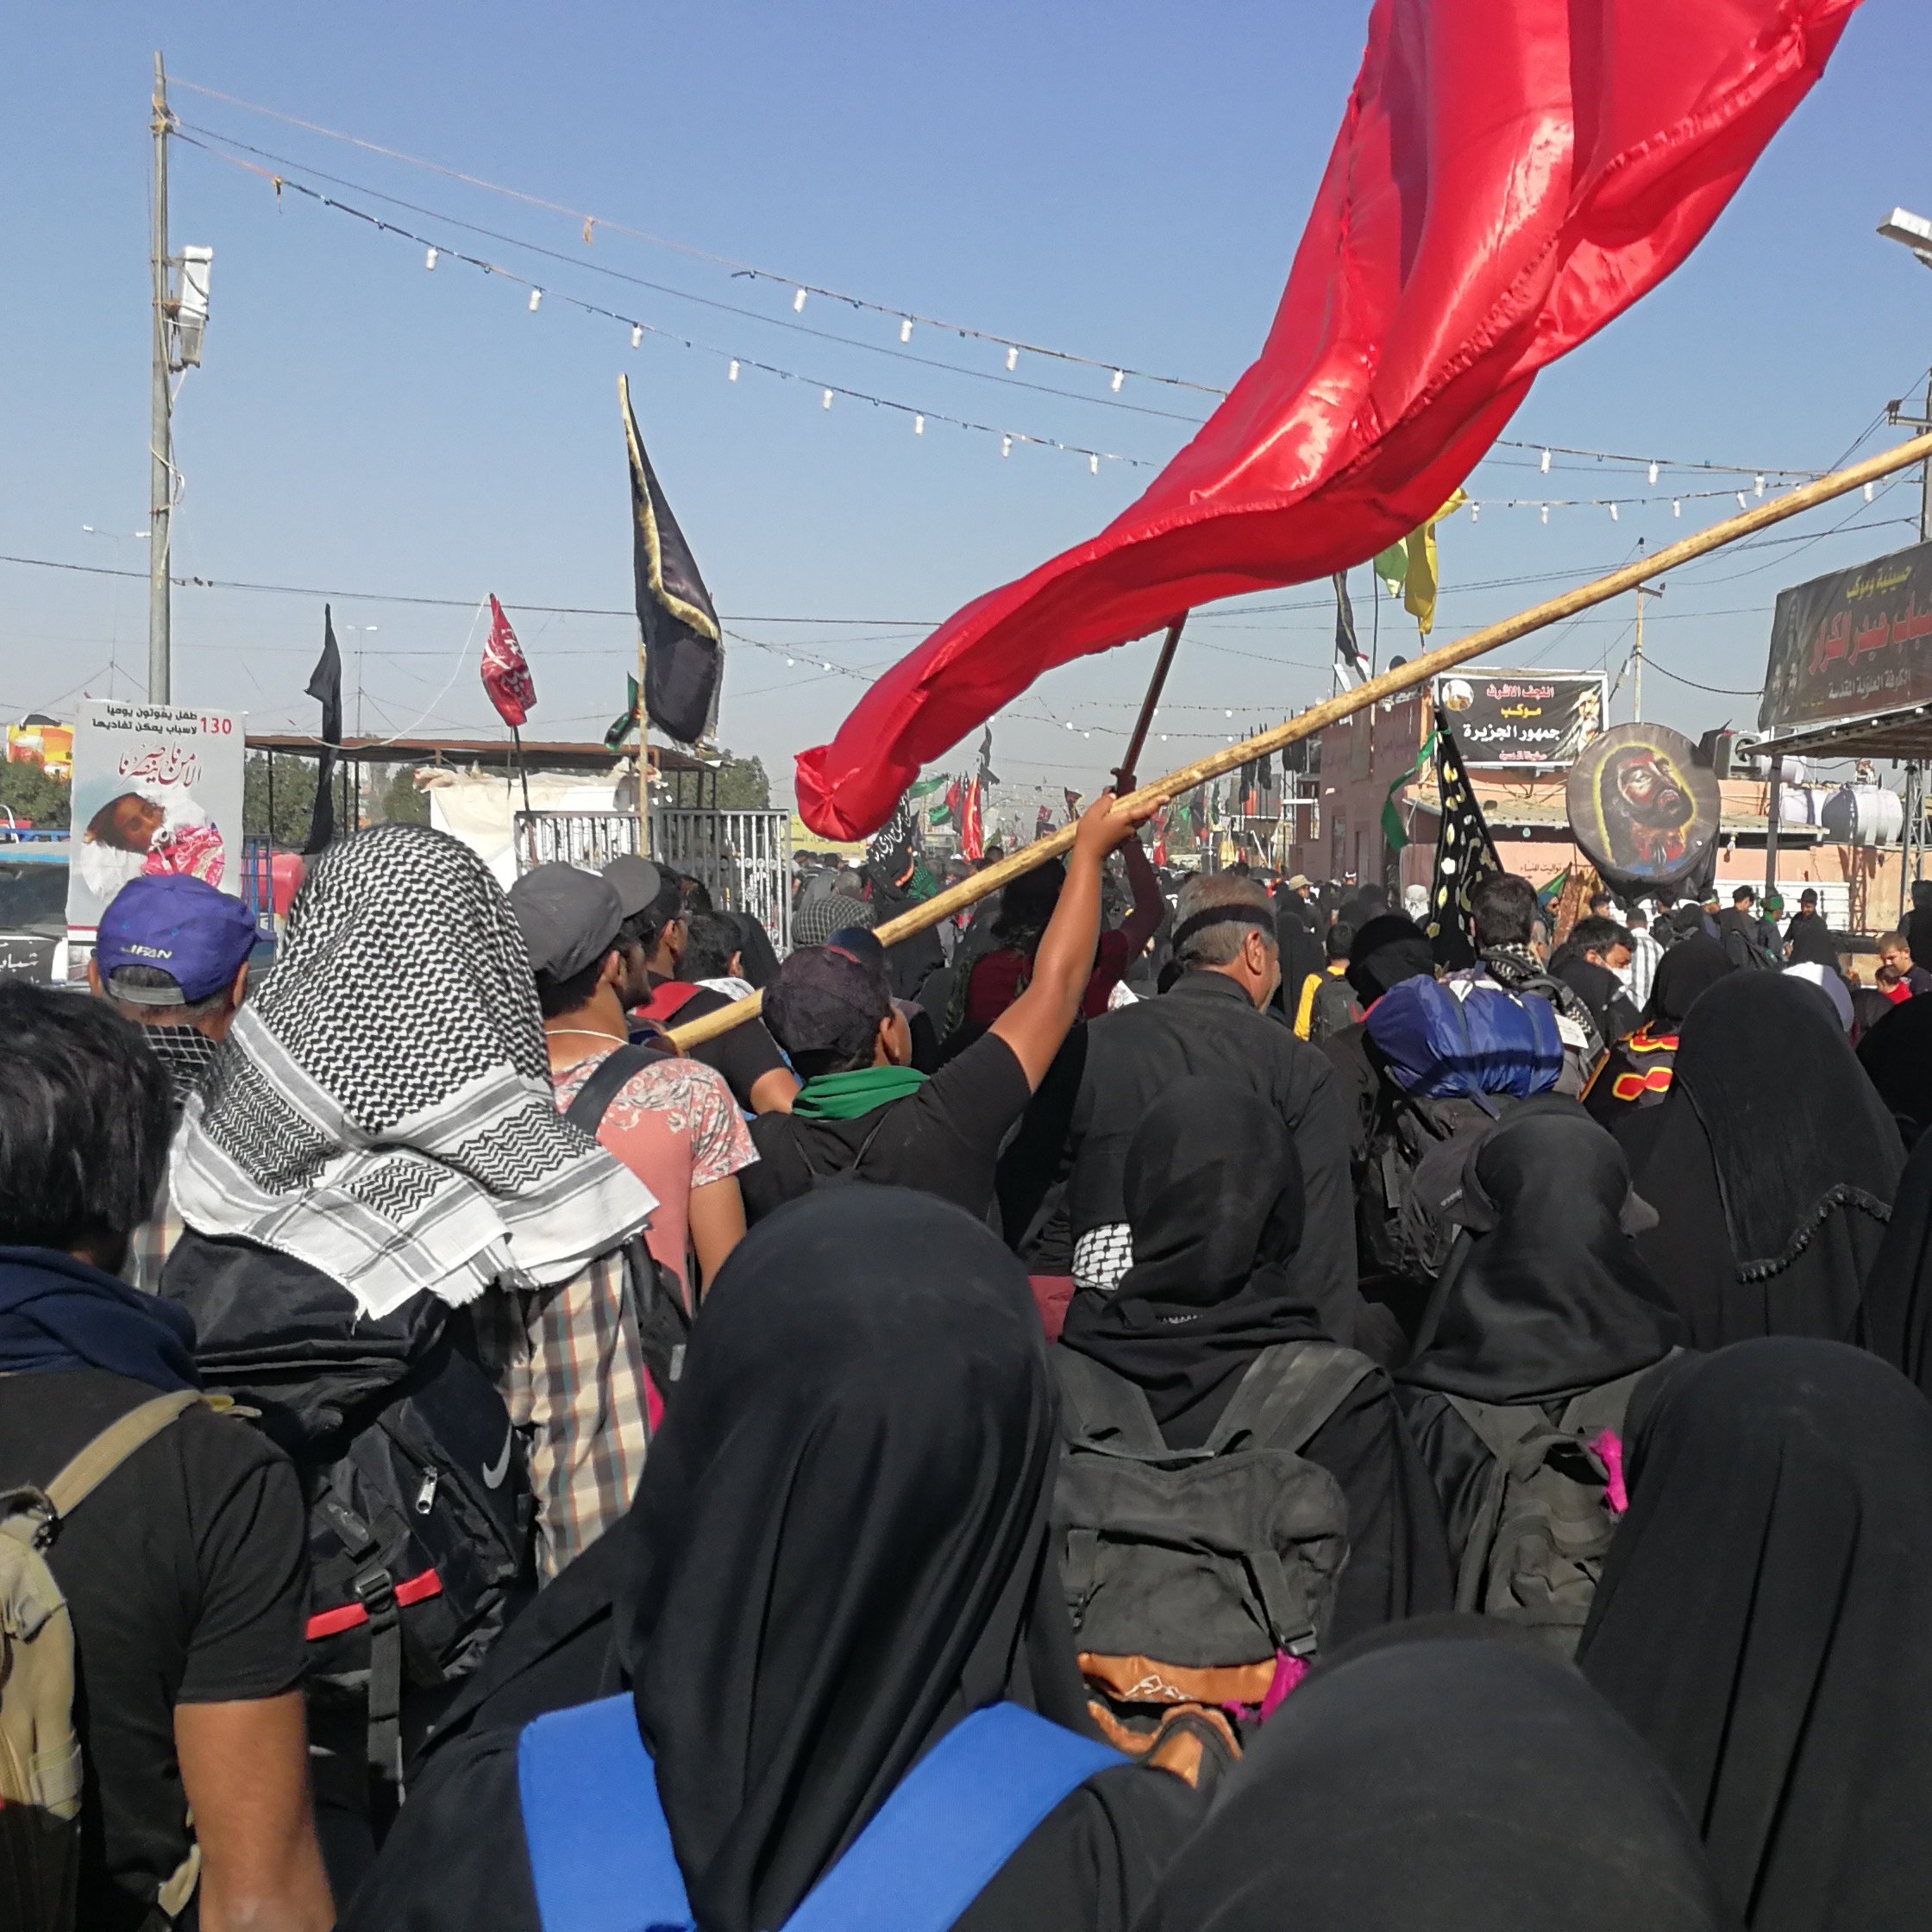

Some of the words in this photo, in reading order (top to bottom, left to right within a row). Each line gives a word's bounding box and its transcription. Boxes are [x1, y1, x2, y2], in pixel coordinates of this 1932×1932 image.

[1876, 566, 1913, 594] حسينية
[1808, 609, 1853, 676] الكرار
[1848, 612, 1891, 667] حيدر
[1521, 684, 1555, 700] النجف
[106, 705, 134, 718] يوميا
[136, 707, 172, 721] يموتون
[175, 711, 198, 721] طفل
[1501, 703, 1542, 719] موكب
[92, 718, 133, 731] تفاديها
[135, 721, 164, 733] يمكن
[200, 717, 232, 735] 130
[1462, 724, 1518, 743] الجزيرة
[1518, 727, 1560, 742] جمهور
